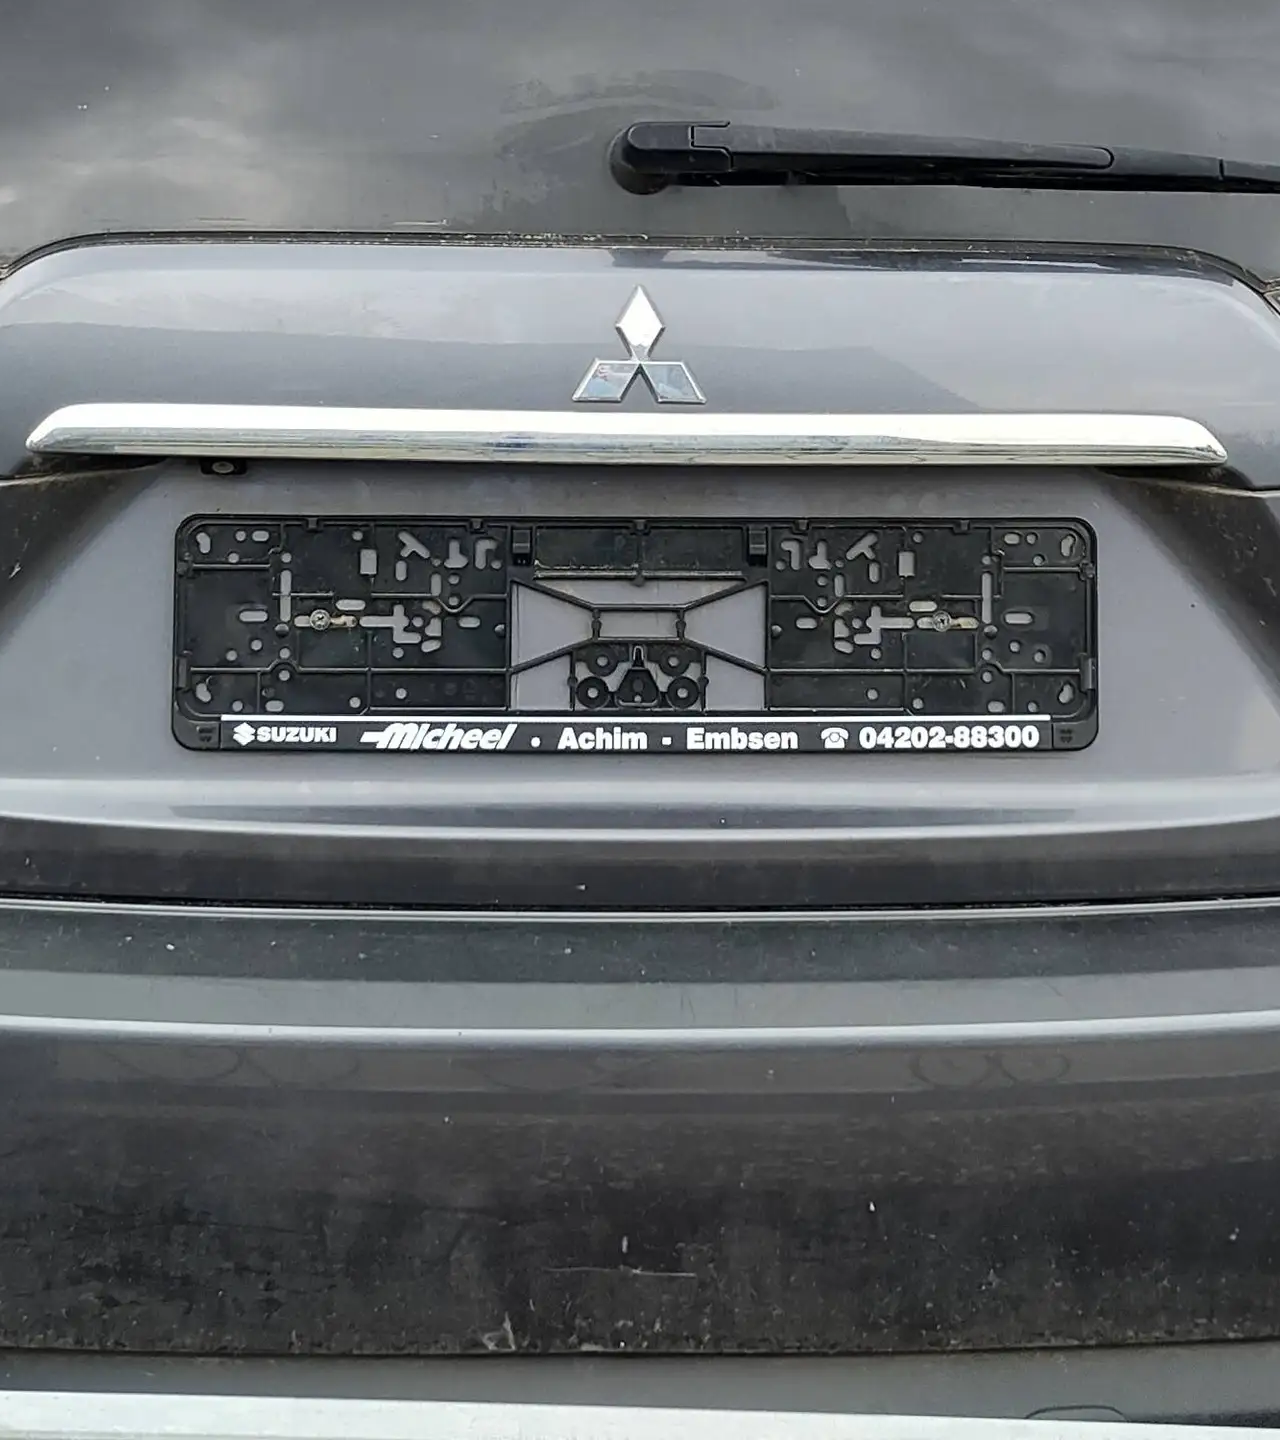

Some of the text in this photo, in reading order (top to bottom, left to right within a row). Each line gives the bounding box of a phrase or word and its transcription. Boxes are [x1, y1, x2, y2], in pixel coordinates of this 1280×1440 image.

[256, 726, 337, 743] SUZUKI
[558, 727, 648, 749] Achim
[686, 727, 798, 749] Embsen
[859, 726, 1039, 748] 04202-88300
